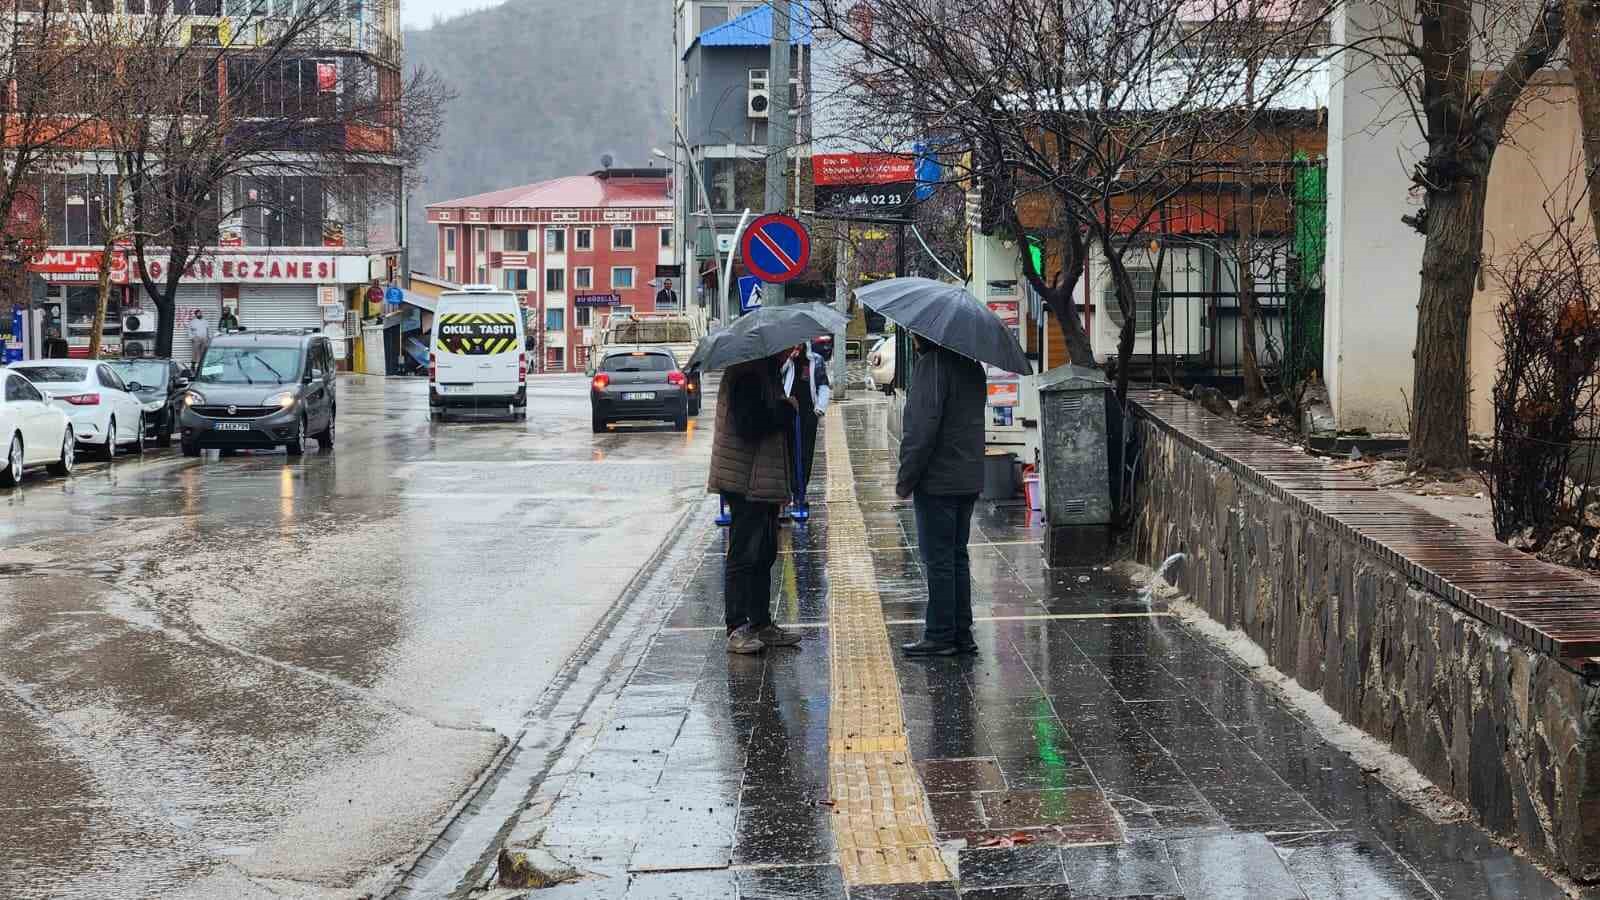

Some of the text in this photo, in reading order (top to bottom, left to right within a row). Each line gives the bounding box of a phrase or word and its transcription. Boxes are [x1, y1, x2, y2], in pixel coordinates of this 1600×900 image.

[848, 194, 902, 204] 444 02 23
[442, 325, 474, 334] OKUL
